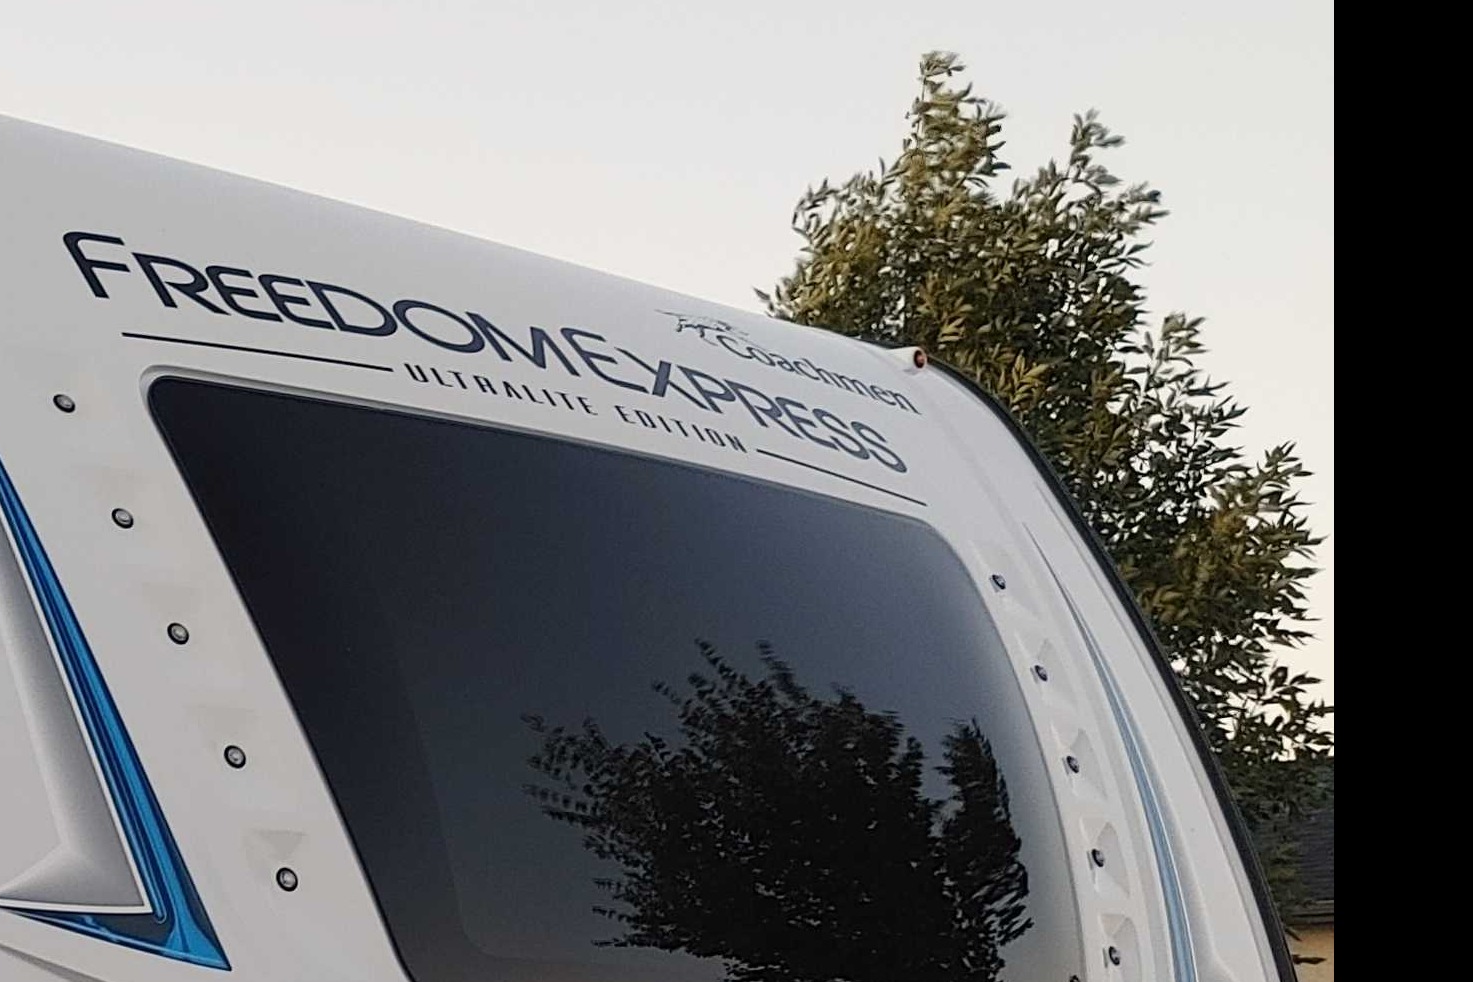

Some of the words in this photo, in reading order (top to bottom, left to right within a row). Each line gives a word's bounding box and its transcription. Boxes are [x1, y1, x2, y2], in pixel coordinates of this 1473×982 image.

[404, 363, 598, 416] ULTRALITE
[618, 406, 748, 454] EDITION
[717, 334, 922, 416] Coachmen
